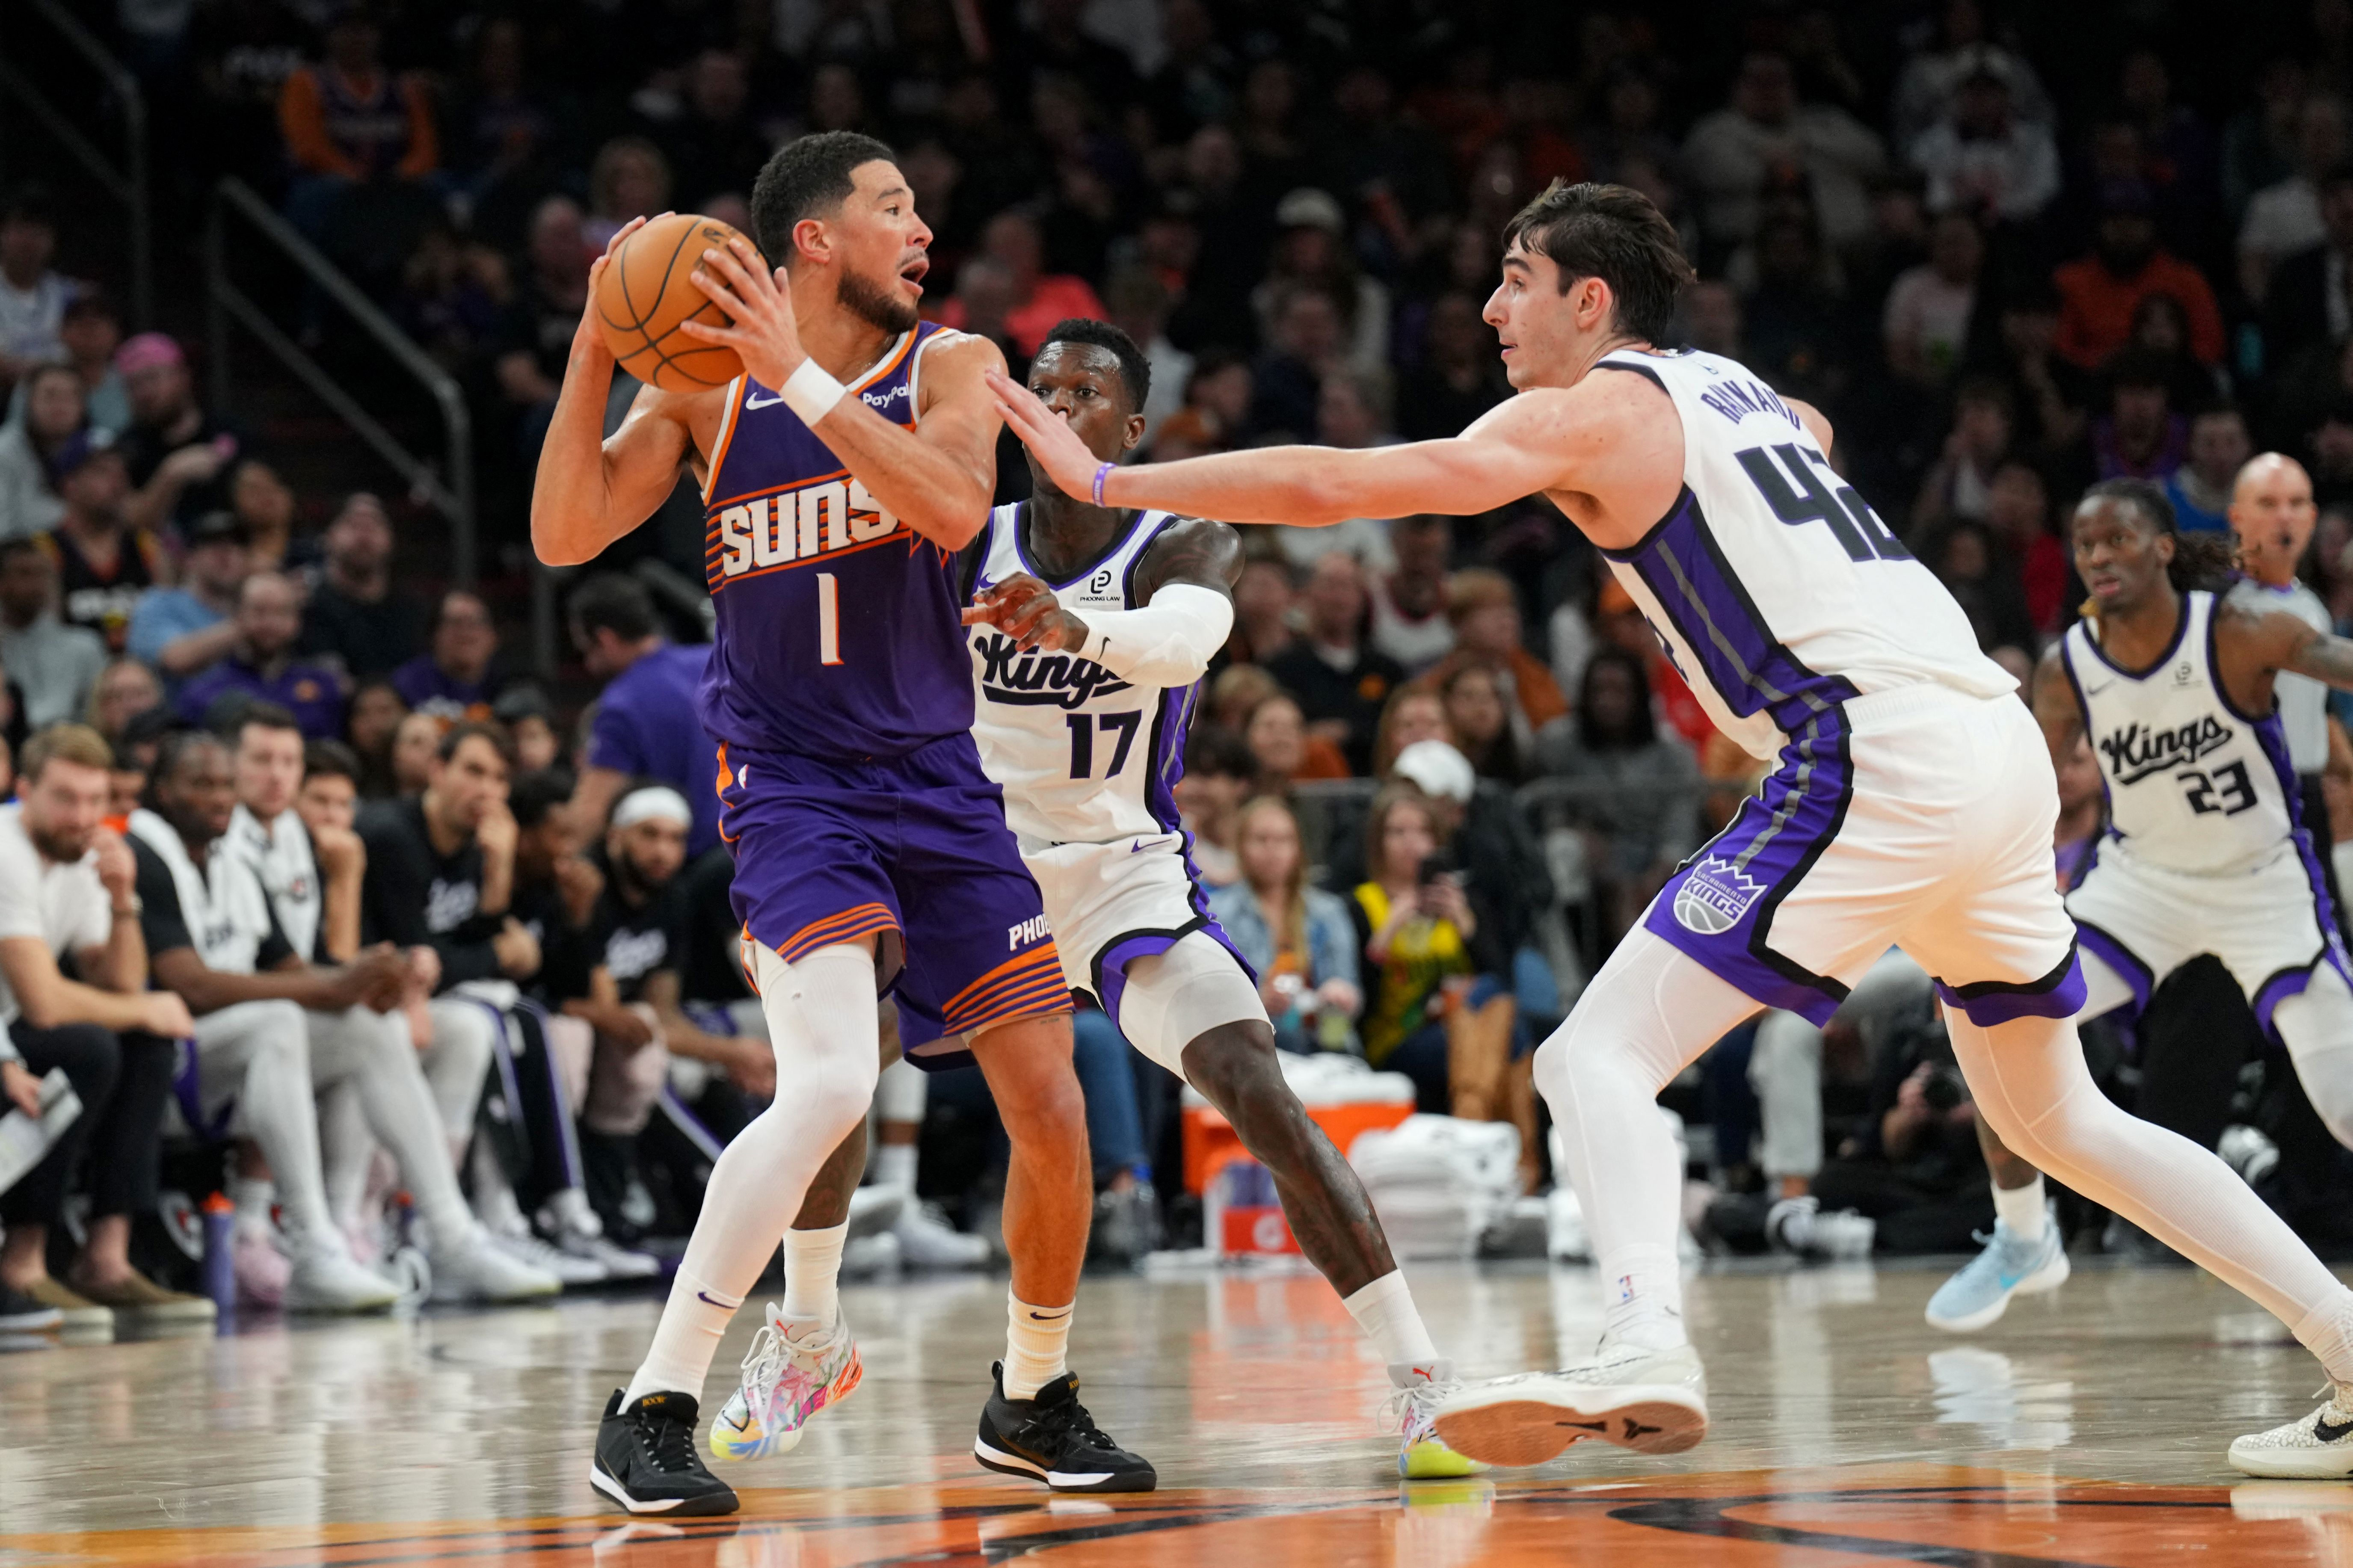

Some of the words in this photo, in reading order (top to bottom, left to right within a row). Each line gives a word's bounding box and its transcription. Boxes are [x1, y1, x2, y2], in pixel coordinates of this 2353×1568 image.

[862, 382, 910, 408] PayPal
[721, 478, 899, 577] SUNS
[816, 573, 844, 666] 1
[1067, 709, 1141, 780] 17
[2100, 715, 2233, 785] Kings
[2177, 759, 2258, 816] 23
[1684, 879, 1743, 920] KINGS
[1695, 871, 1748, 905] SACRAMENTO
